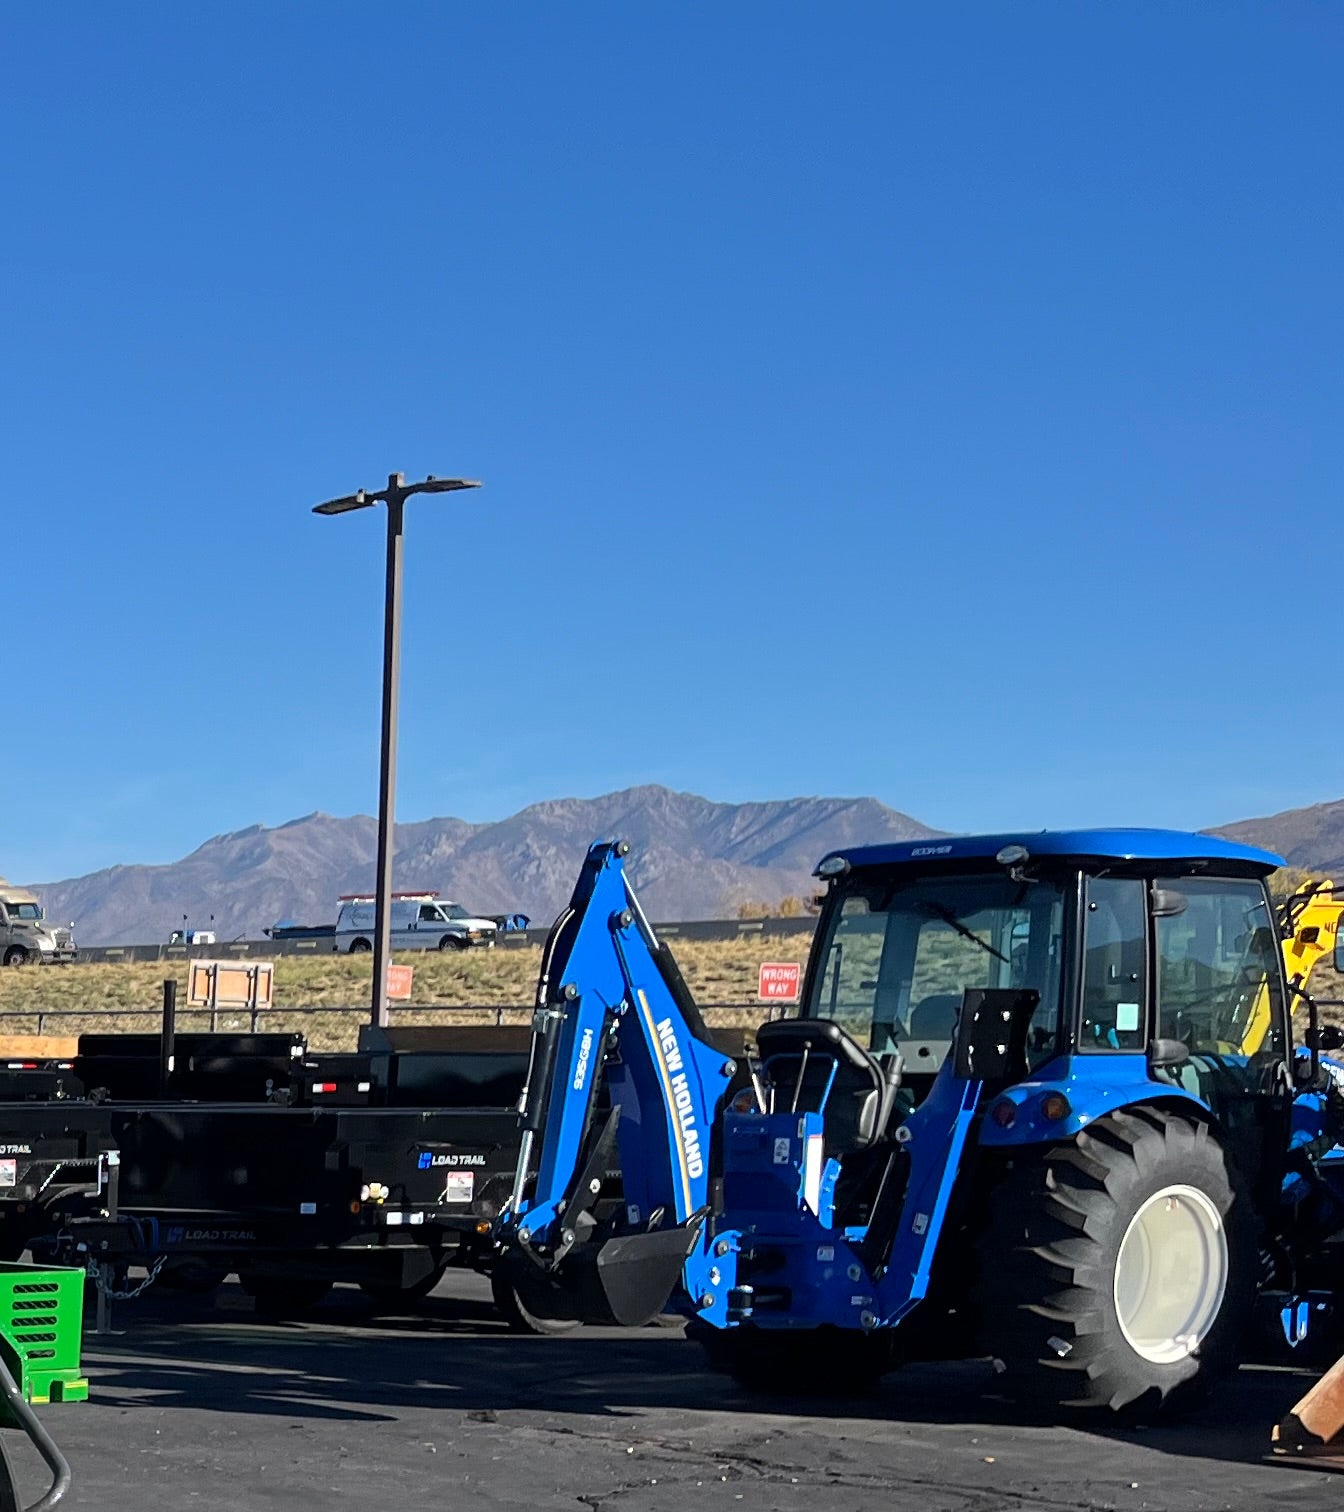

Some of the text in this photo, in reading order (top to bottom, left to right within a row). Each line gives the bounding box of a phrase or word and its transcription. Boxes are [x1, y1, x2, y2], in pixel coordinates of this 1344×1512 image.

[762, 968, 797, 981] WRONG
[767, 982, 789, 995] WAY
[656, 1017, 704, 1180] NEW HOLLAND
[7, 1144, 32, 1154] TRAIL
[432, 1155, 486, 1166] LOAD TRAIL
[185, 1230, 257, 1240] LOAD TRAIL
